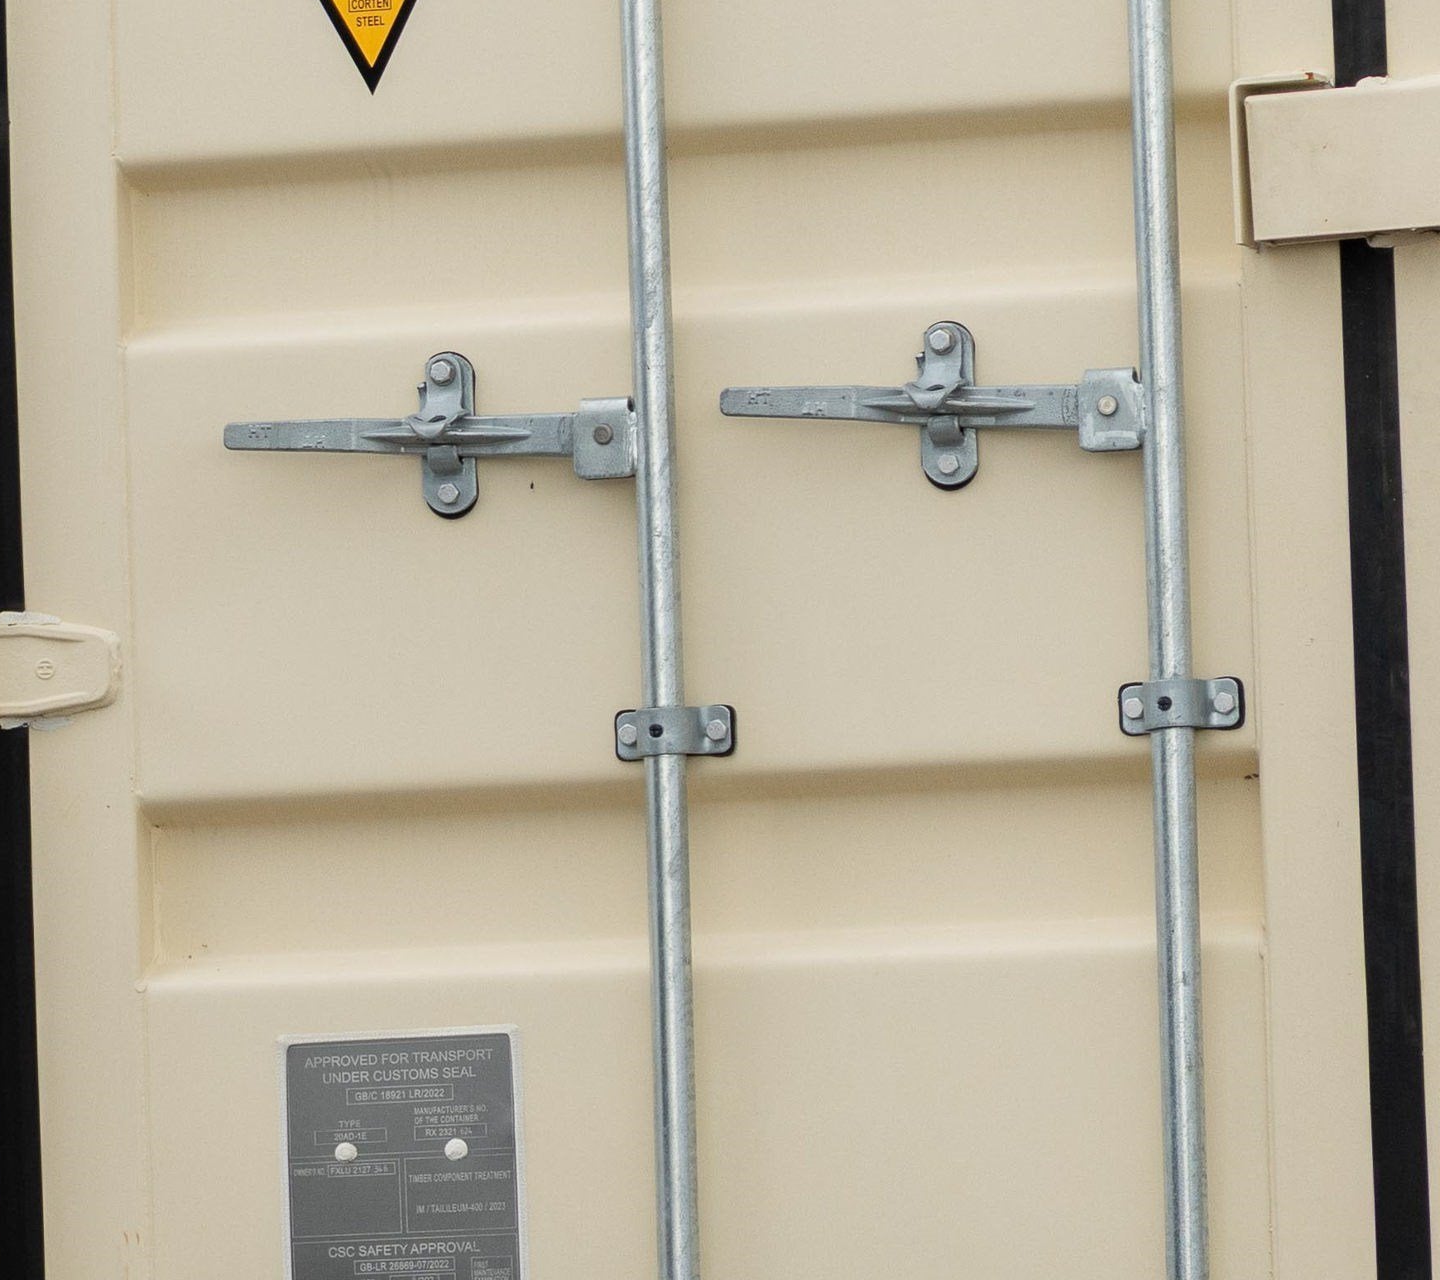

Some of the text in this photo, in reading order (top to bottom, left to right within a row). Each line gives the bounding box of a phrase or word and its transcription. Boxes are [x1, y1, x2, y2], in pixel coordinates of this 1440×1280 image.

[356, 16, 385, 28] STEEL
[304, 1048, 492, 1068] APPROVED FOR TRANSPORT
[322, 1065, 476, 1084] UNDER CUSTOMS SEAL
[355, 1091, 377, 1101] GB/C
[408, 1088, 444, 1098] LR/2022
[338, 1119, 360, 1128] TYPE
[440, 1113, 478, 1123] CONTAINER
[408, 1170, 511, 1183] TIMBER COMPONENT TREATMENT
[328, 1240, 480, 1258] CSC SAFETY APPROVAL
[359, 1262, 387, 1272] GB-LR
